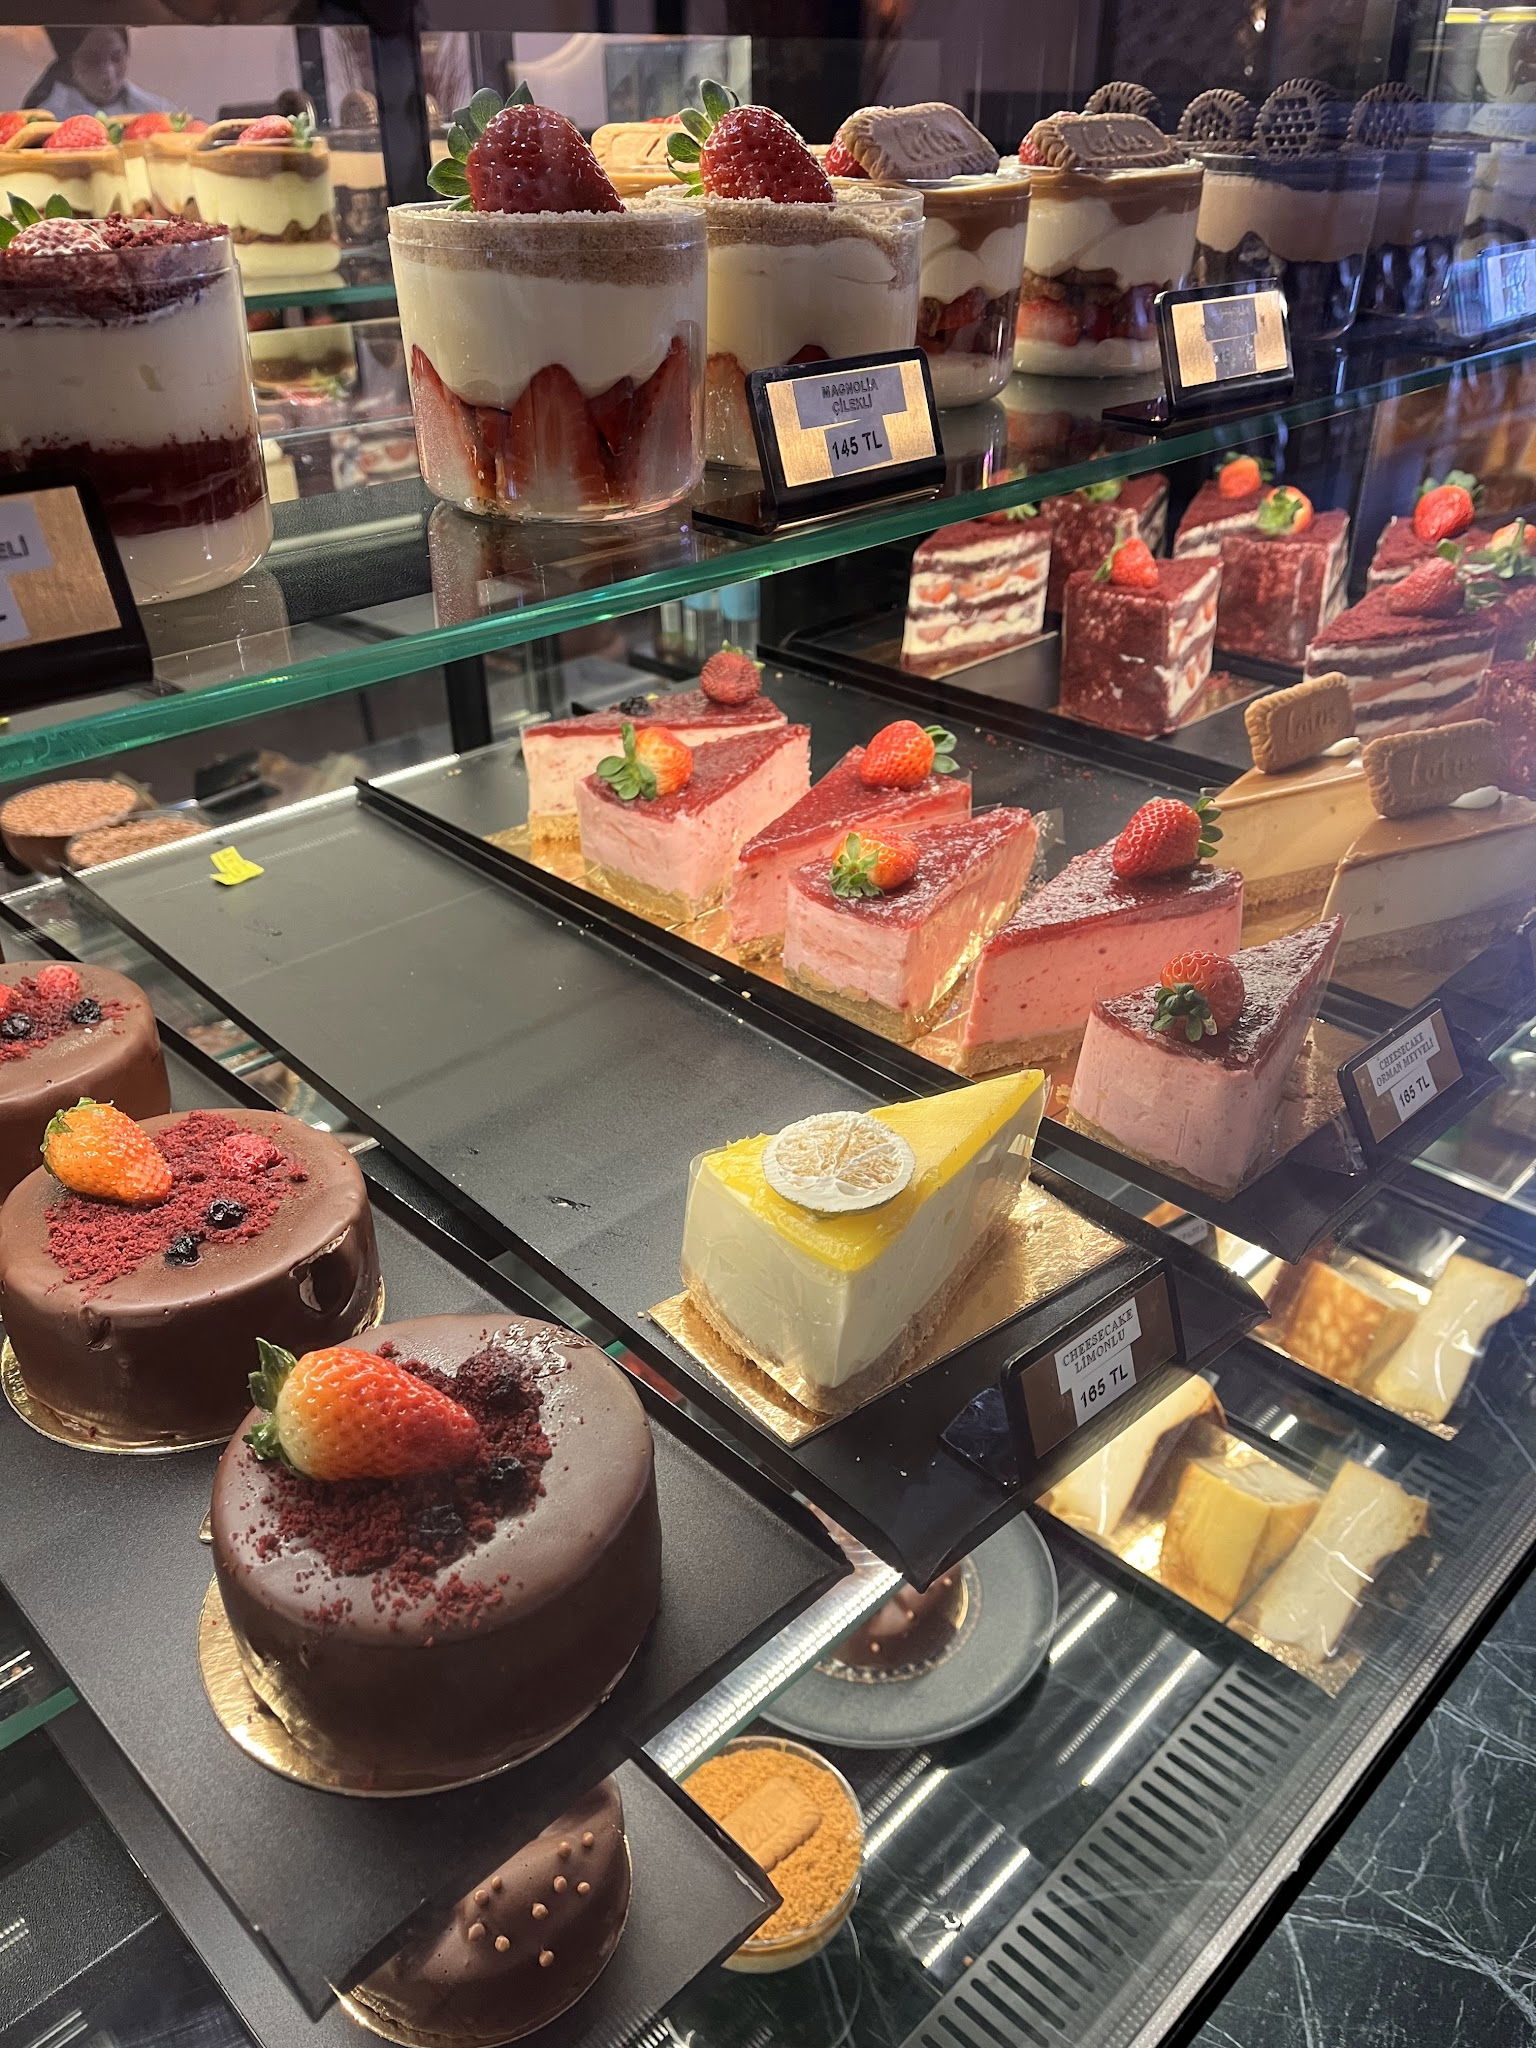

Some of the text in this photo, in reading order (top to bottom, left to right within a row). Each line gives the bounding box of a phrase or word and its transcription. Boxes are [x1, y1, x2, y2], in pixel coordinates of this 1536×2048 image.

[832, 431, 883, 460] 145 TL
[1379, 1032, 1424, 1071] CHEESECAKE
[1376, 1060, 1403, 1087] ORMAN
[1400, 1076, 1430, 1107] 165 TL
[1063, 1308, 1133, 1367] CHEESECAKE
[1074, 1329, 1126, 1374] LİMONLU
[1080, 1364, 1129, 1408] 165 TL
